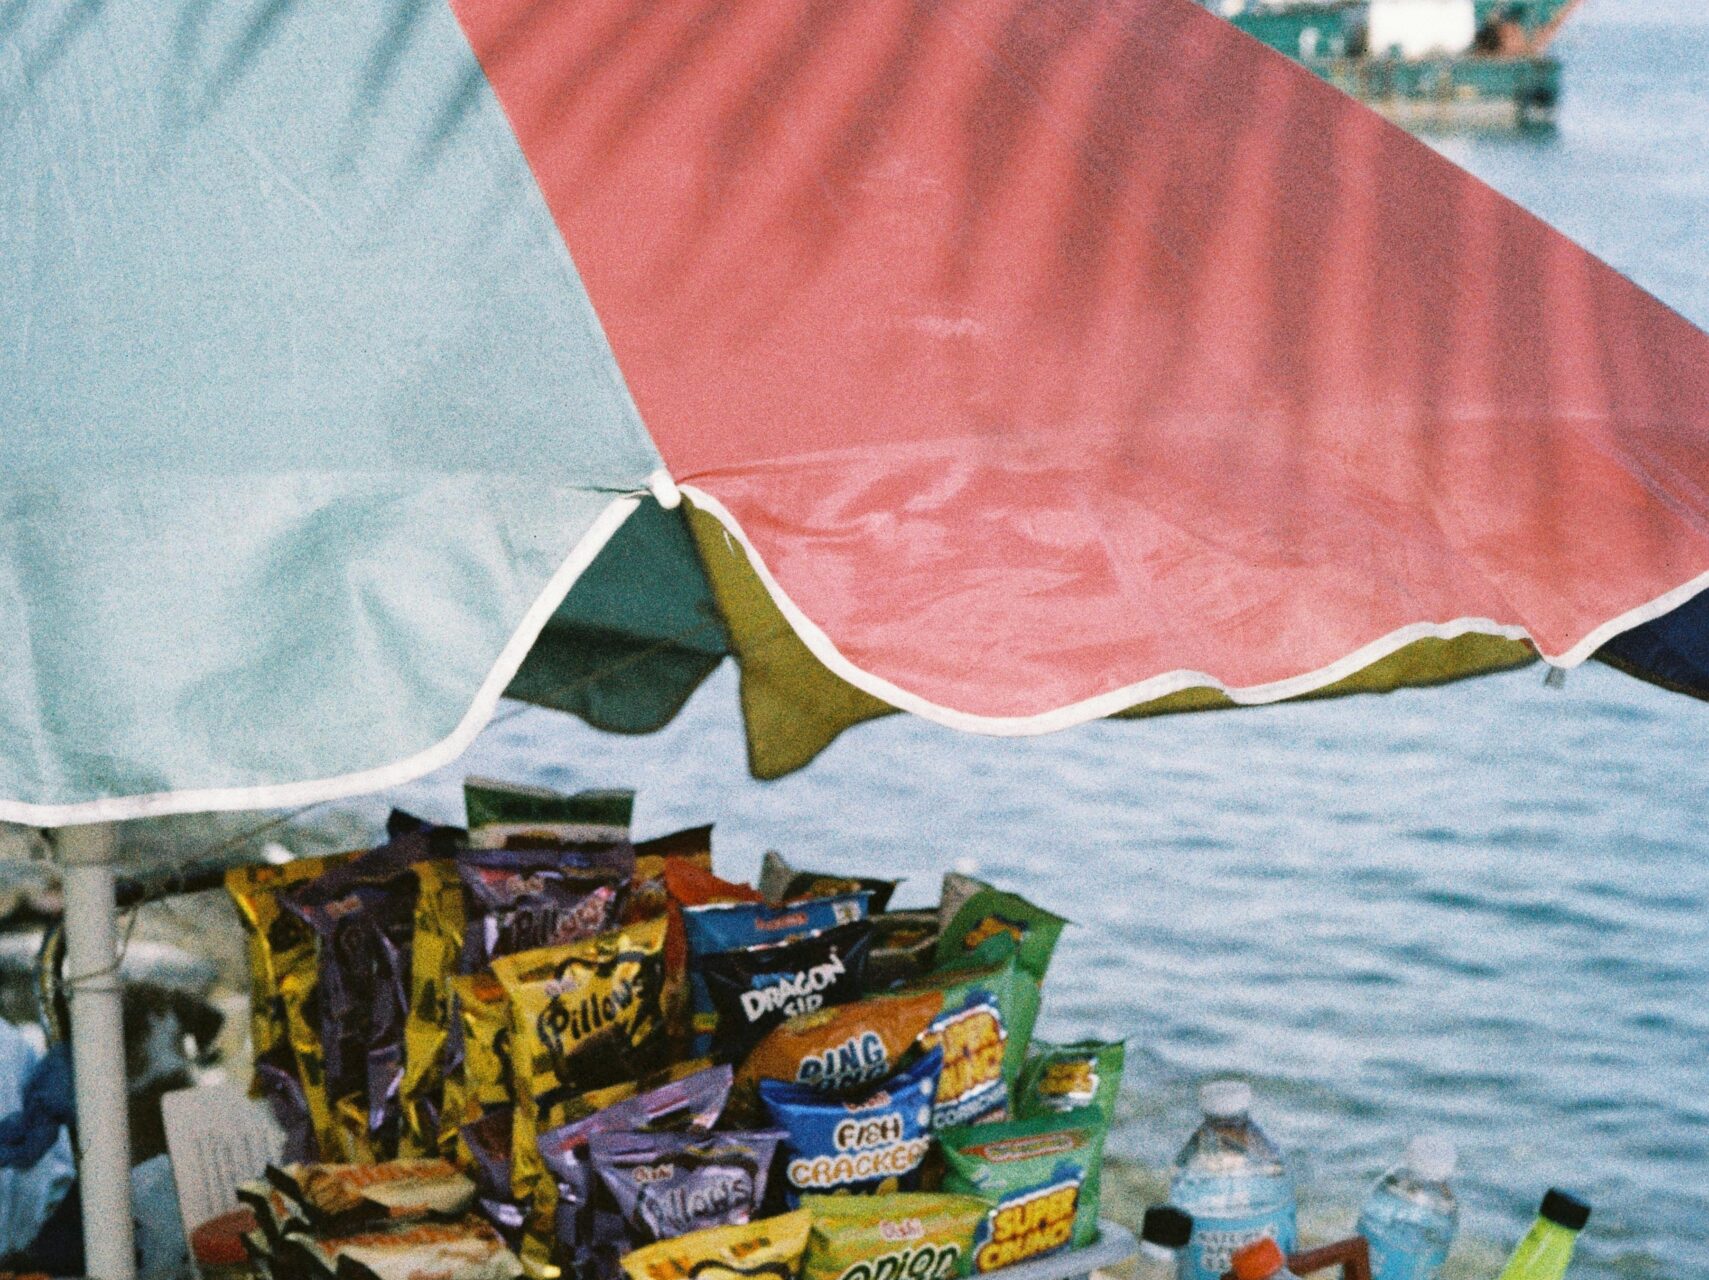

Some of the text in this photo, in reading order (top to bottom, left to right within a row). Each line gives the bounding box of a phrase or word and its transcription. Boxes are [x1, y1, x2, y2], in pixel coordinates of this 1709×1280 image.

[543, 973, 645, 1050] Pillows
[740, 952, 846, 1023] DRAGON
[836, 1114, 902, 1149] FISH
